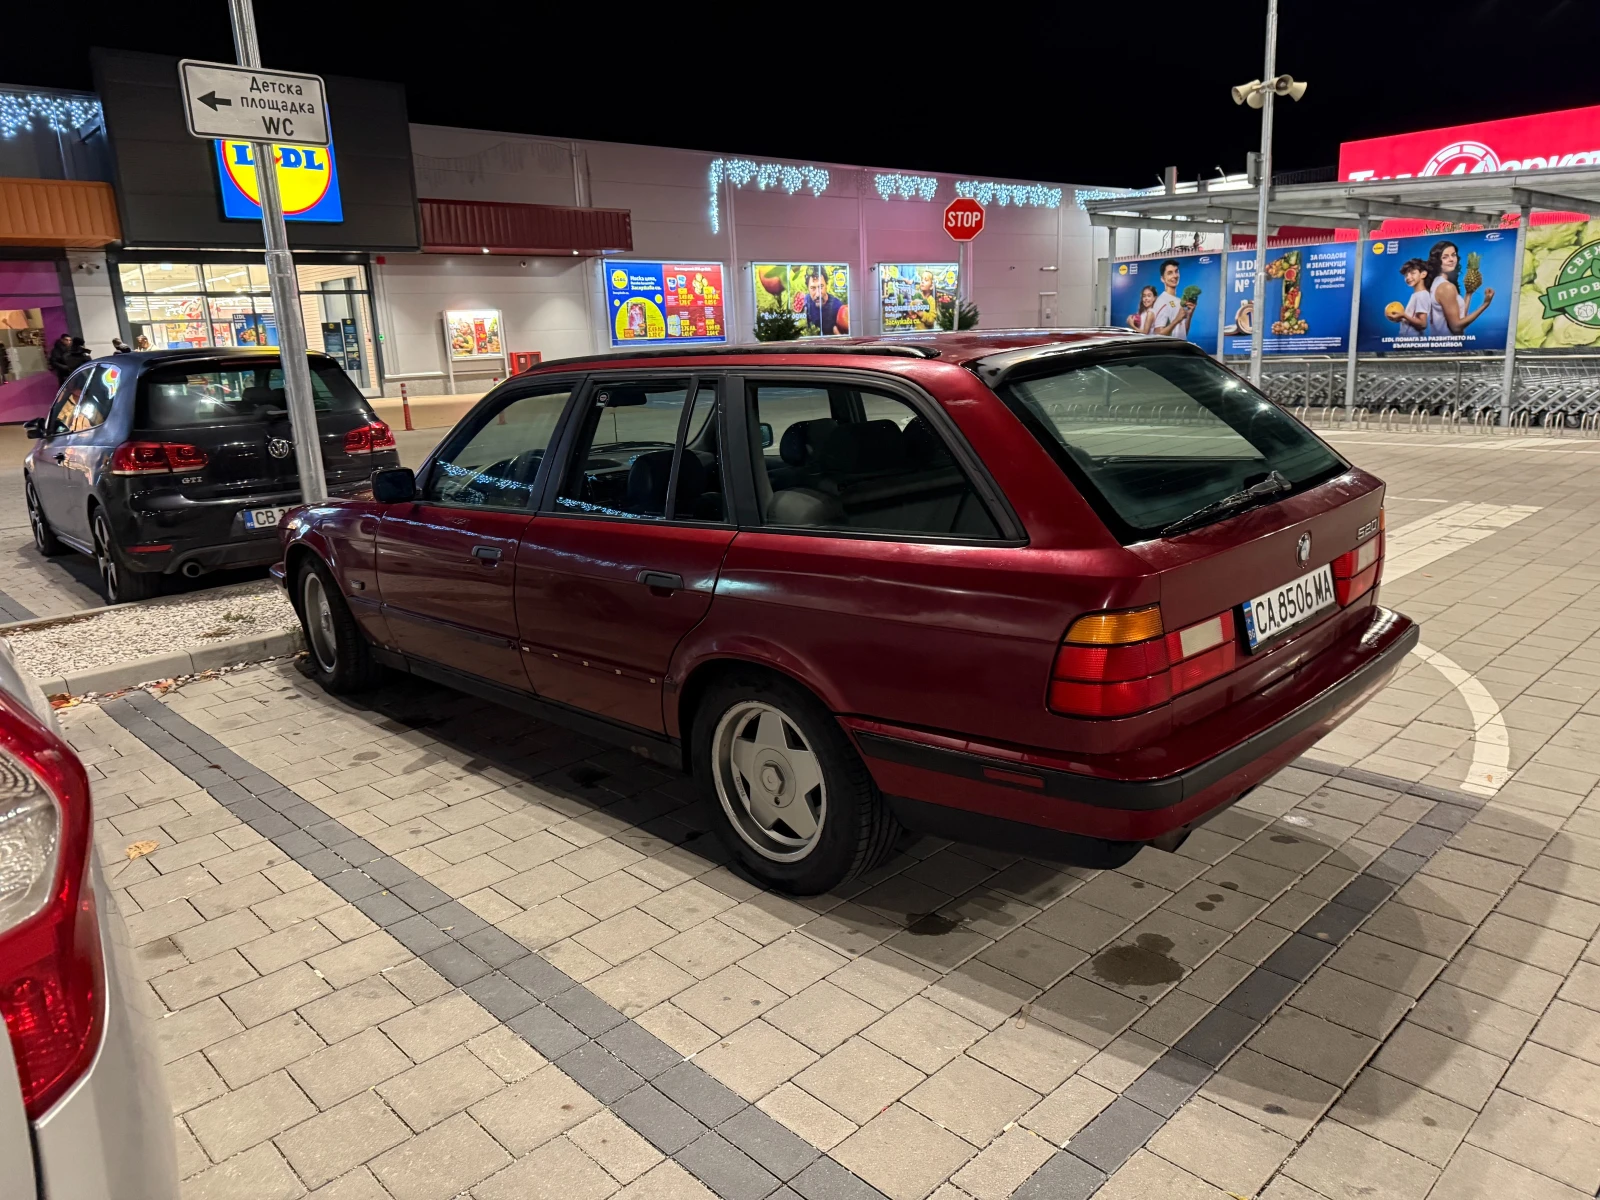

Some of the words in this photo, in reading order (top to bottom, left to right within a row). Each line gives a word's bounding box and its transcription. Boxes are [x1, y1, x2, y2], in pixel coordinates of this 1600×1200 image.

[249, 76, 303, 96] Детска
[240, 96, 315, 115] площадка
[261, 115, 294, 136] WC
[232, 144, 324, 170] LDL
[947, 211, 981, 228] STOP
[1312, 260, 1346, 268] ЗЕЛЕНЧУЦИ
[1318, 252, 1347, 260] ПЛОДОВЕ
[182, 476, 203, 484] GTI
[255, 510, 276, 526] CB
[1278, 579, 1313, 623] 8506
[1313, 570, 1332, 606] MA
